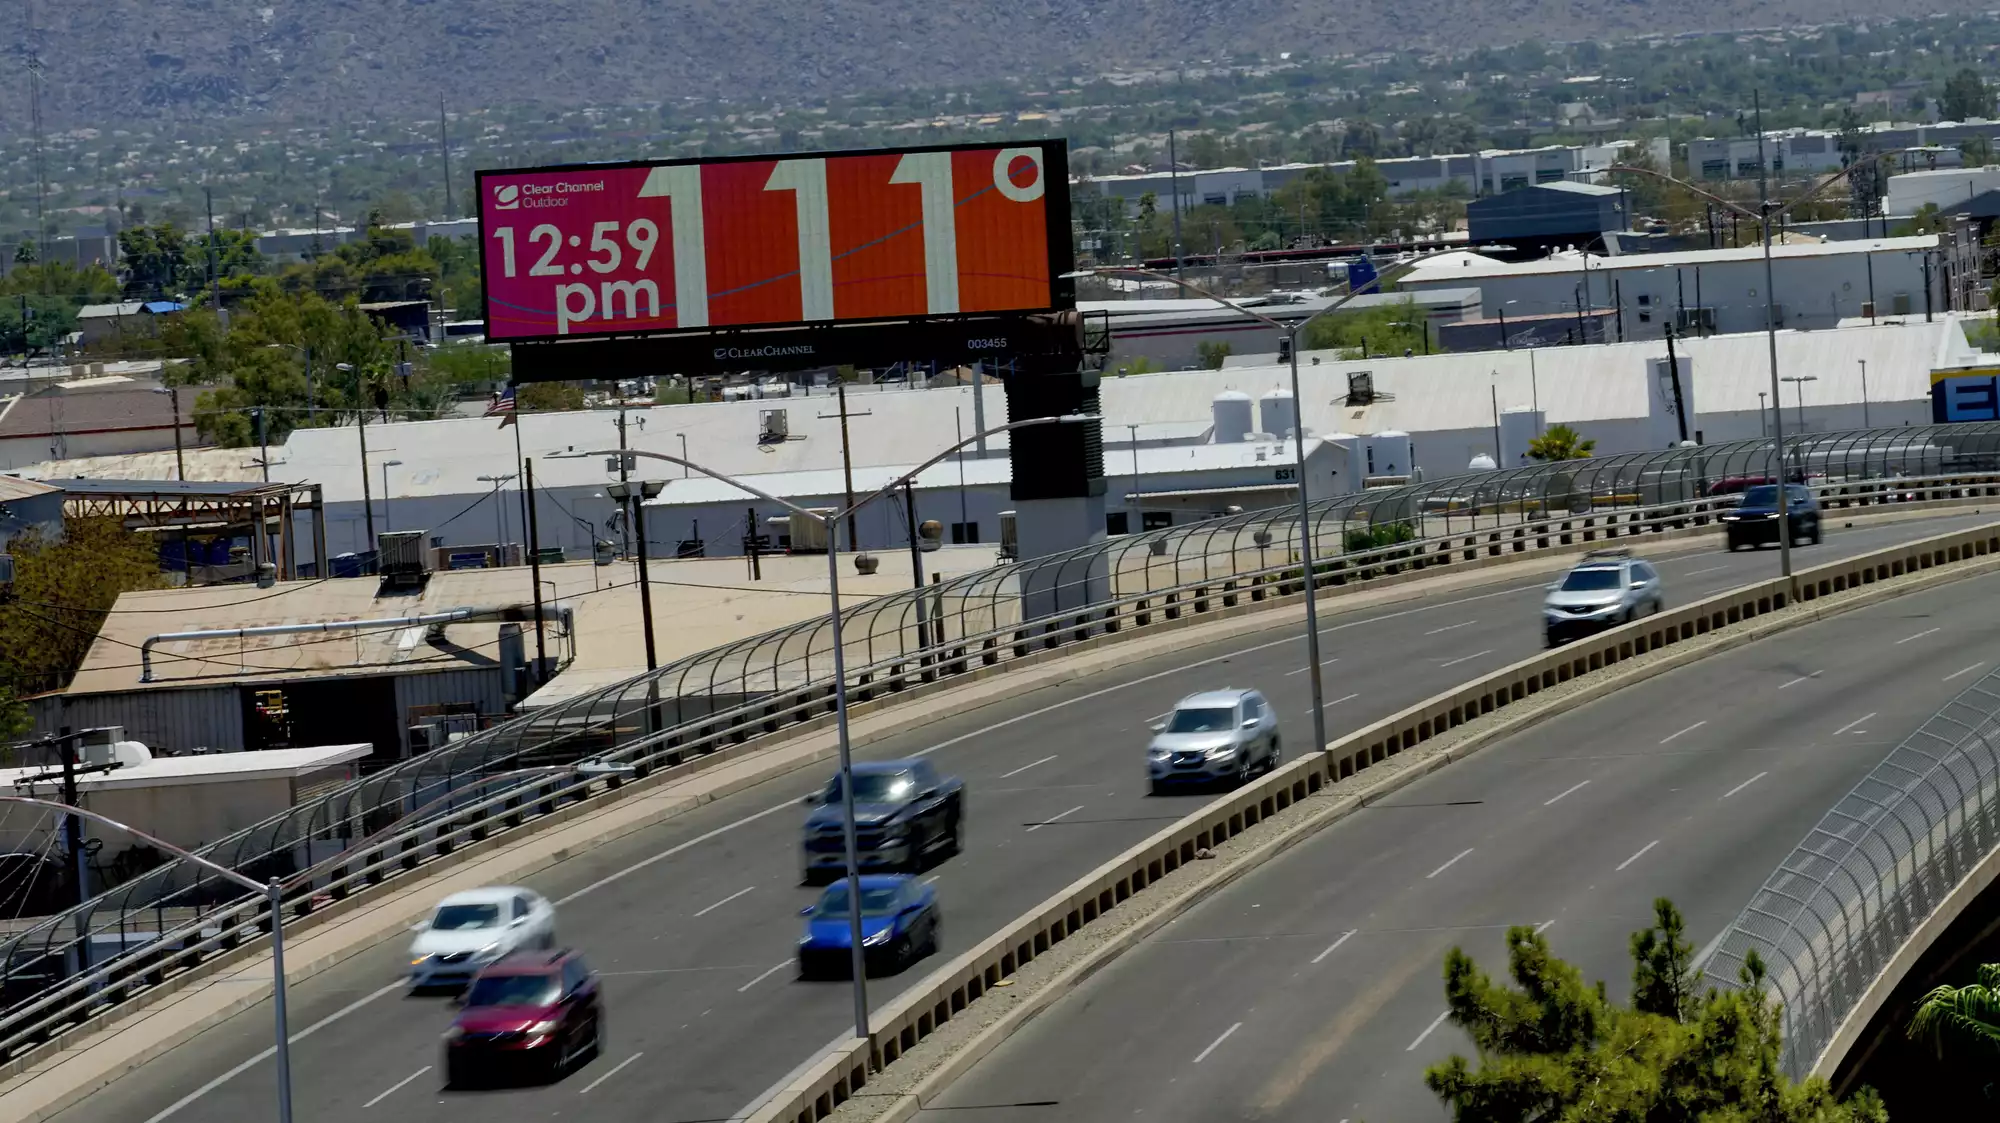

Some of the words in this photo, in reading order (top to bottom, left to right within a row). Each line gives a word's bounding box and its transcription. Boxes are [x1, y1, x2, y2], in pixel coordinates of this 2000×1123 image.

[522, 183, 553, 195] Clear
[556, 180, 604, 194] Channel
[522, 196, 569, 209] Outdoor
[493, 218, 659, 278] 12:59
[556, 278, 660, 335] pm
[967, 337, 1007, 349] 003455
